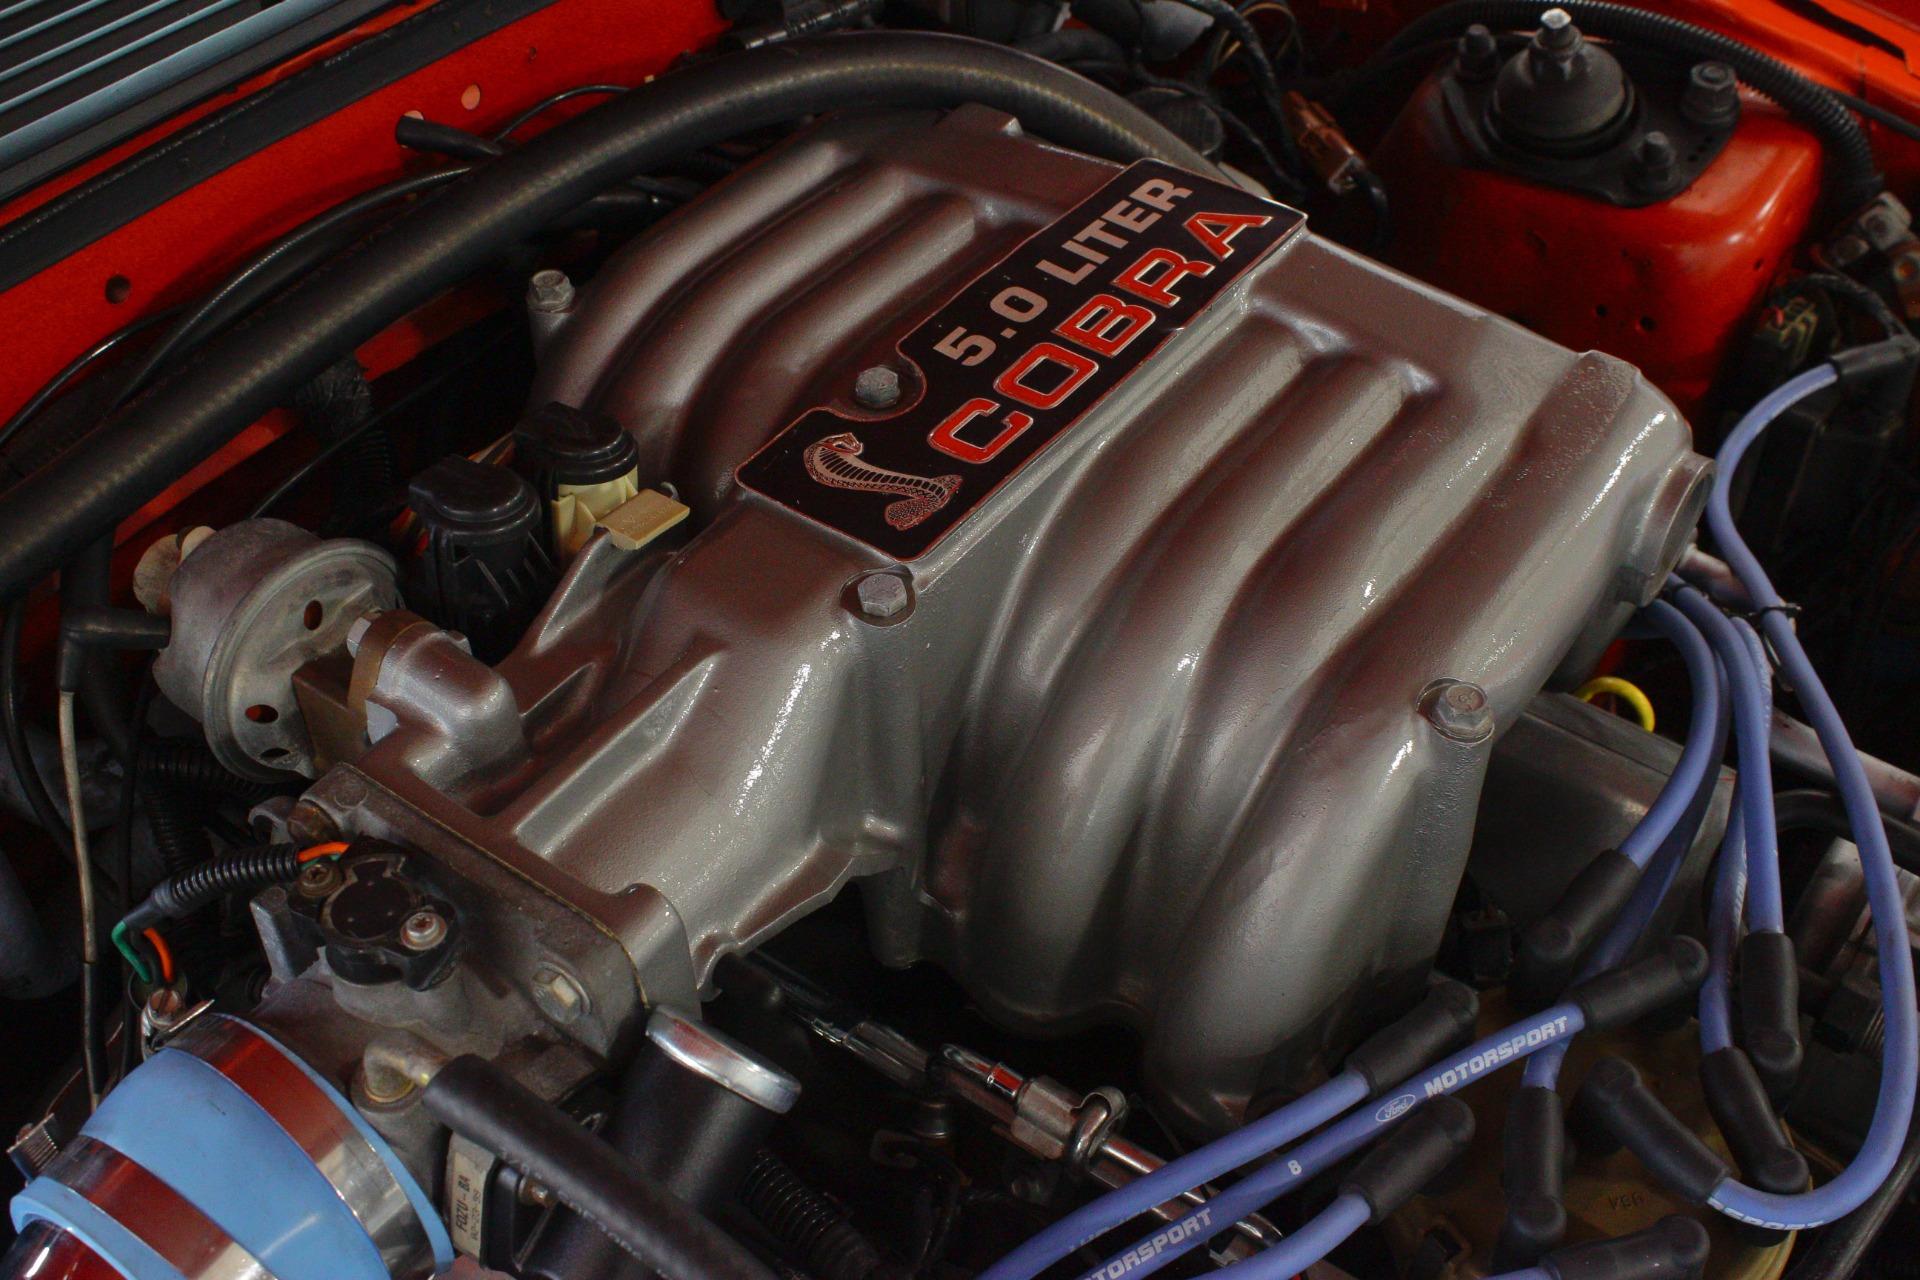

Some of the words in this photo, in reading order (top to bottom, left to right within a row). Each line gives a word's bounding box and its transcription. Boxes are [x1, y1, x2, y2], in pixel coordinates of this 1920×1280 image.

[926, 210, 1274, 465] COBRA
[933, 286, 1048, 367] 5.0
[1035, 177, 1194, 286] LITER
[1287, 1159, 1302, 1175] 8
[1381, 1096, 1411, 1120] Ford
[1424, 1016, 1568, 1097] MOTORSPORT
